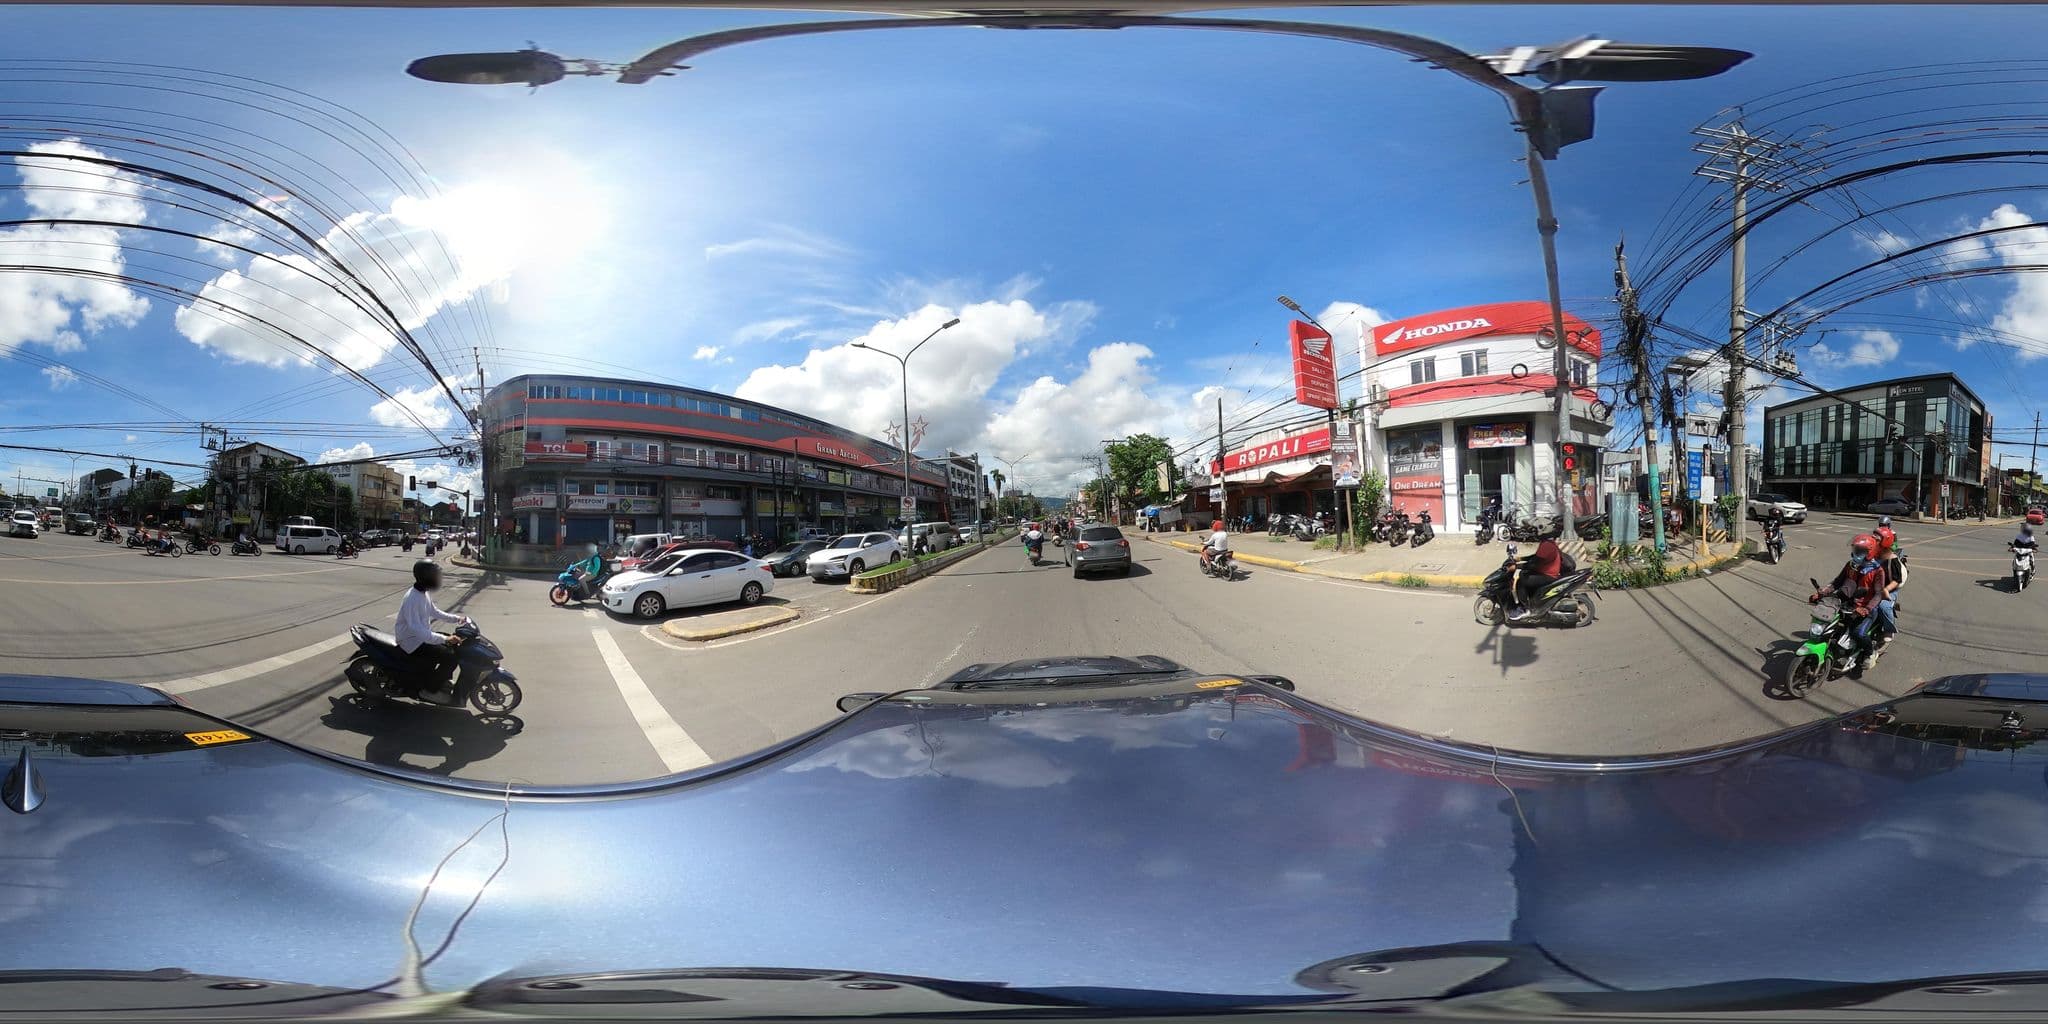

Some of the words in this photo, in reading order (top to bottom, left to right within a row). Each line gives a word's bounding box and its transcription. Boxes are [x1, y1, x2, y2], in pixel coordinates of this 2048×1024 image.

[1405, 318, 1492, 340] HONDA
[1310, 379, 1328, 389] SERVICE
[1395, 464, 1411, 474] GAME
[1412, 461, 1439, 472] CHANGER
[1394, 481, 1411, 490] ONE
[1412, 480, 1441, 489] DREAM
